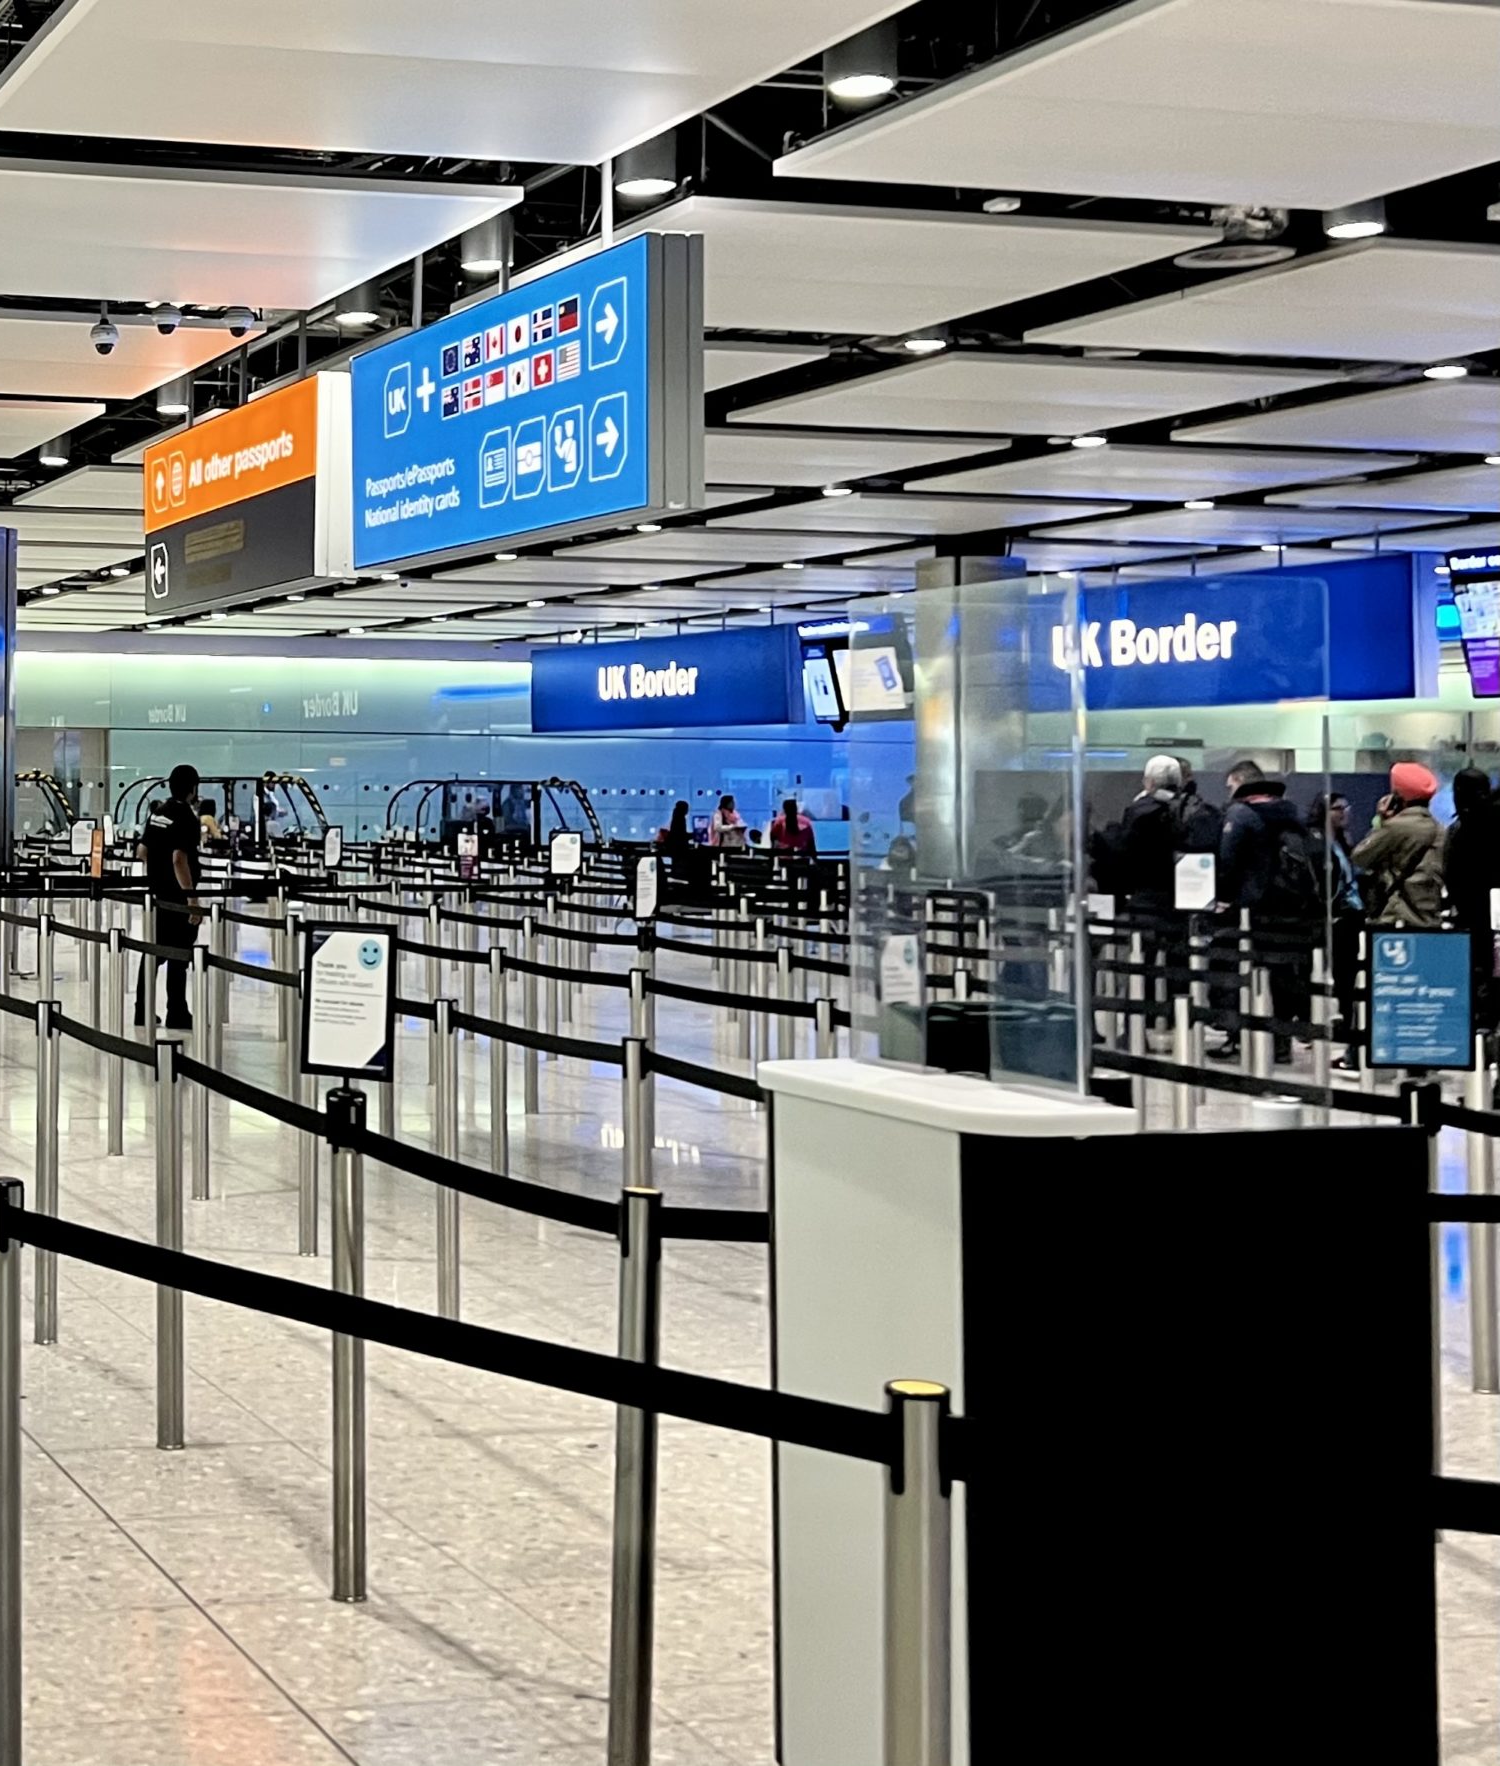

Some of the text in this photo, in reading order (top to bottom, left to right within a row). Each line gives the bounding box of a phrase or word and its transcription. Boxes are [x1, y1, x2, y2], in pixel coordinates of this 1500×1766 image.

[388, 386, 406, 415] UK
[188, 429, 293, 489] All other passports
[365, 457, 455, 498] Passports/ePassports
[365, 485, 460, 528] National identity cards
[1052, 612, 1237, 670] UK Border
[598, 660, 698, 701] UK Border
